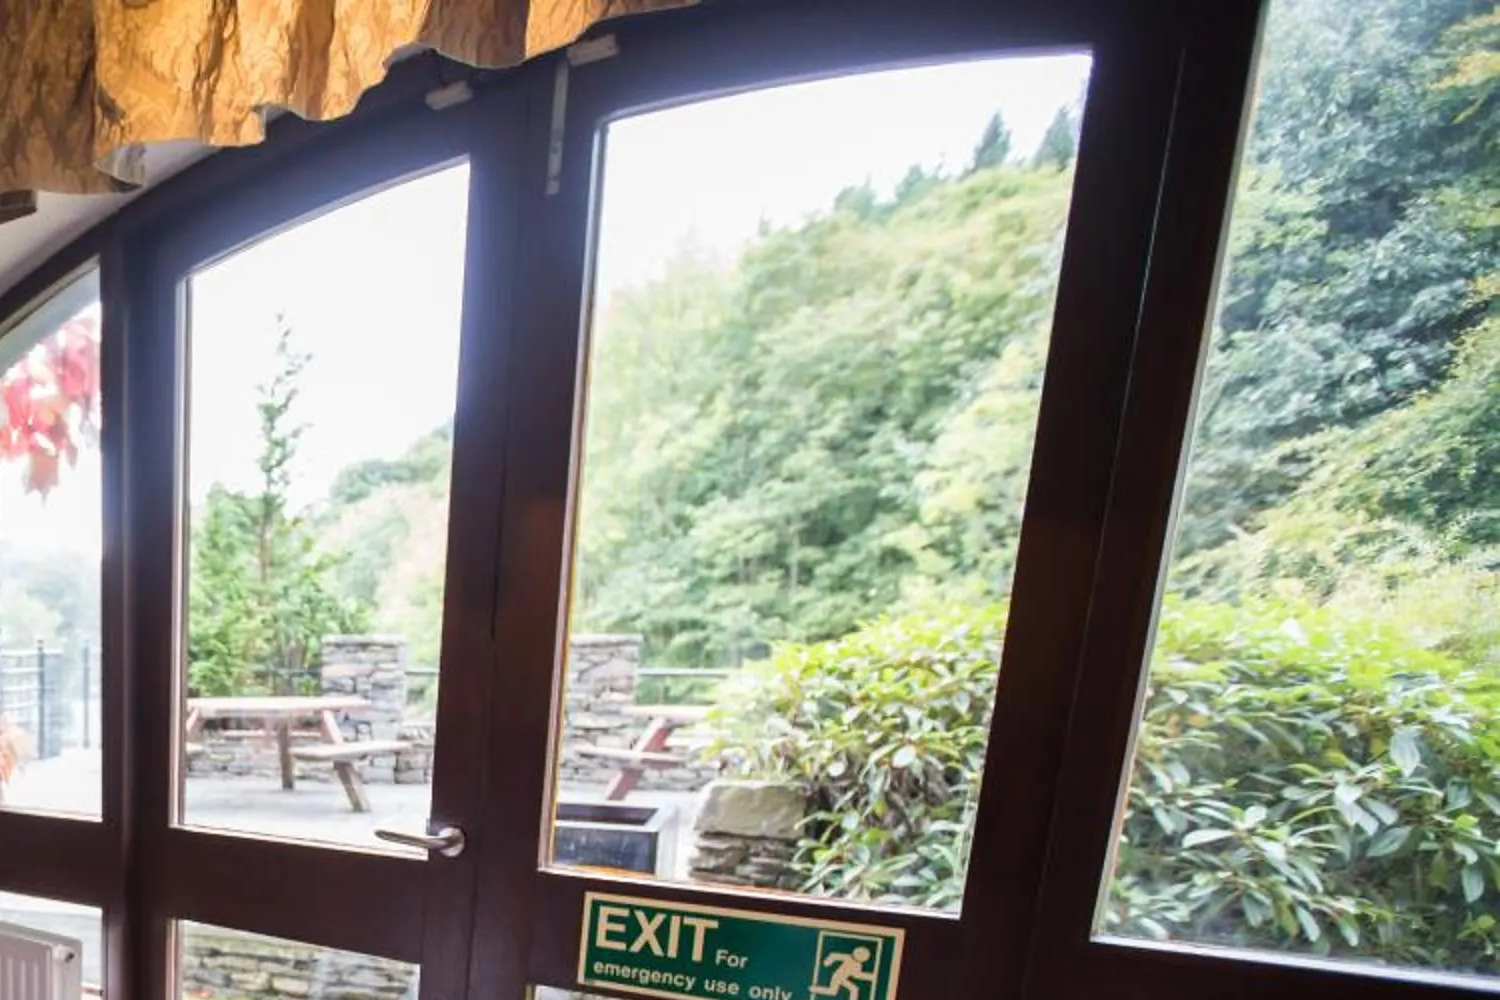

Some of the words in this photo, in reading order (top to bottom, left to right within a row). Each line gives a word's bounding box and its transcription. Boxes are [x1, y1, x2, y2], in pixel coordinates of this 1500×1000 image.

[595, 905, 719, 962] EXIT
[715, 949, 748, 969] For
[593, 960, 696, 989] emergency
[704, 977, 740, 996] use
